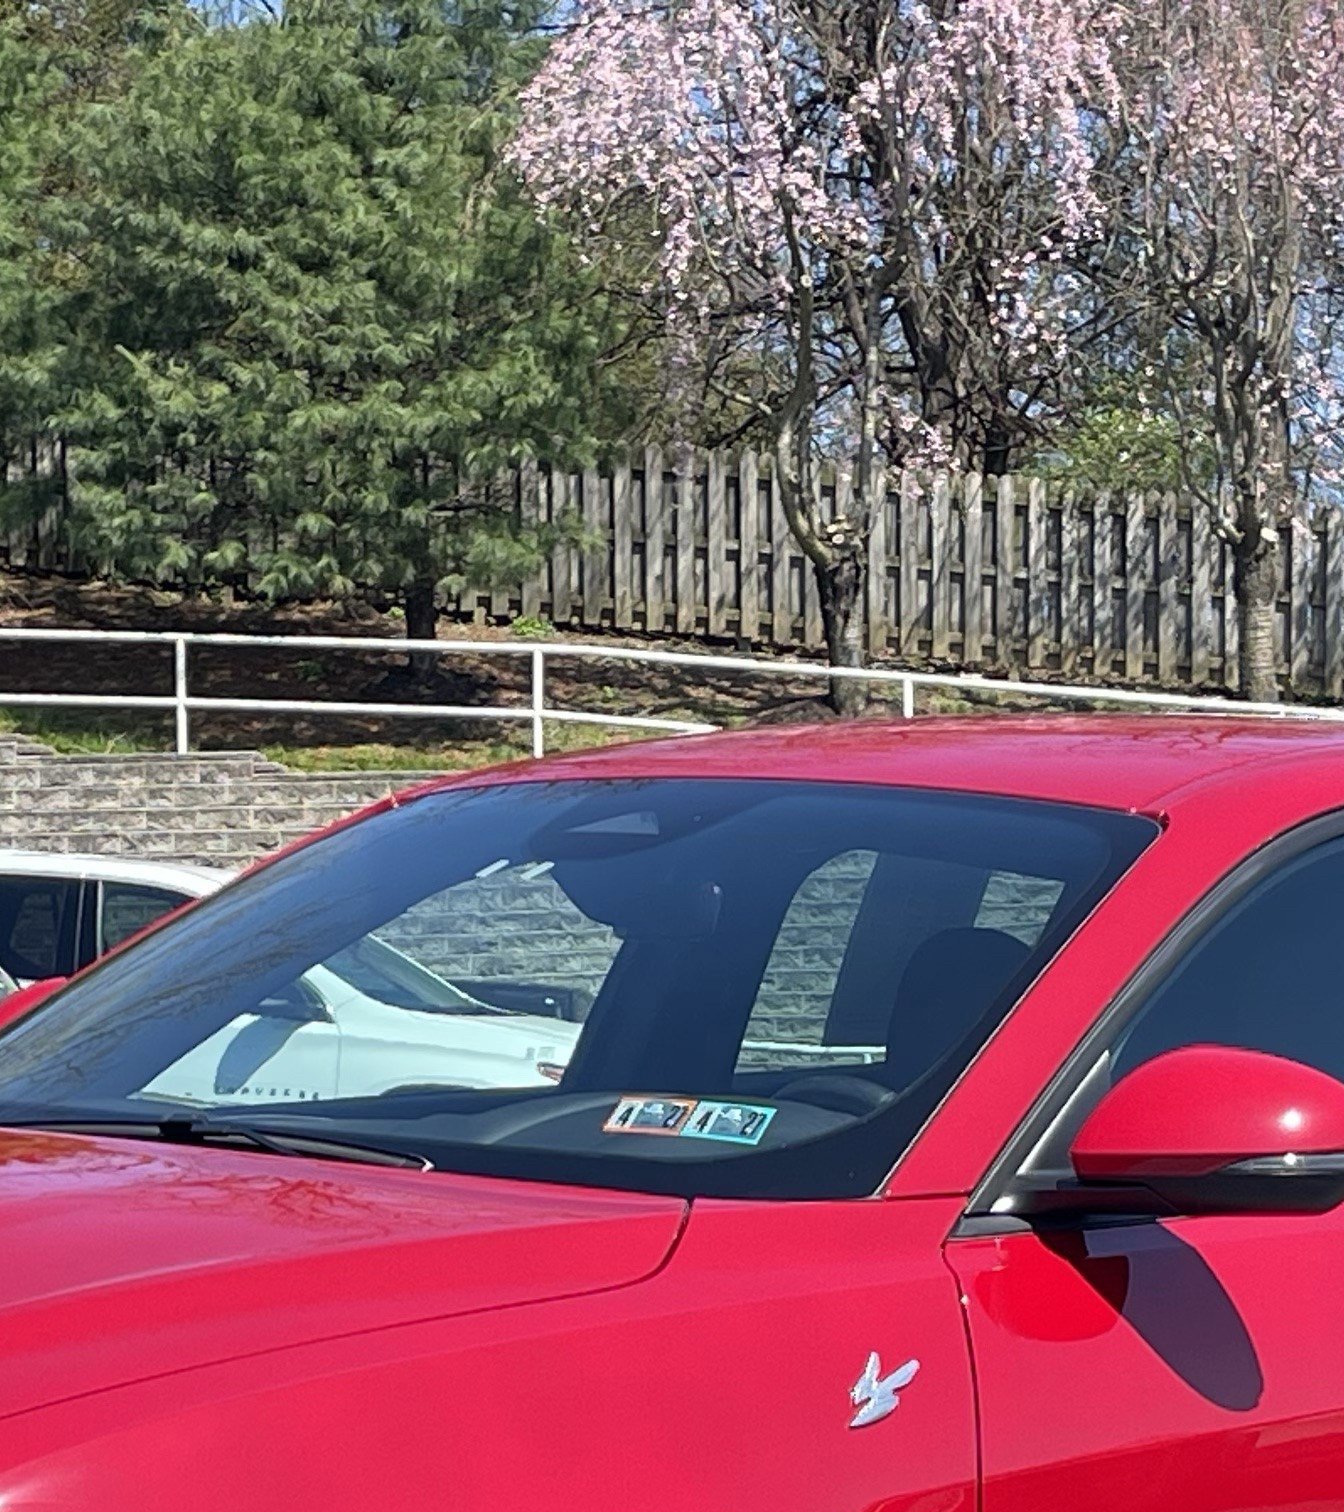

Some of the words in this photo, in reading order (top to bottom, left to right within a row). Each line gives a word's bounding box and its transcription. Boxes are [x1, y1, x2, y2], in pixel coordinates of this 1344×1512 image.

[616, 1106, 634, 1127] 4
[696, 1110, 714, 1132] 4
[739, 1112, 767, 1136] 27
